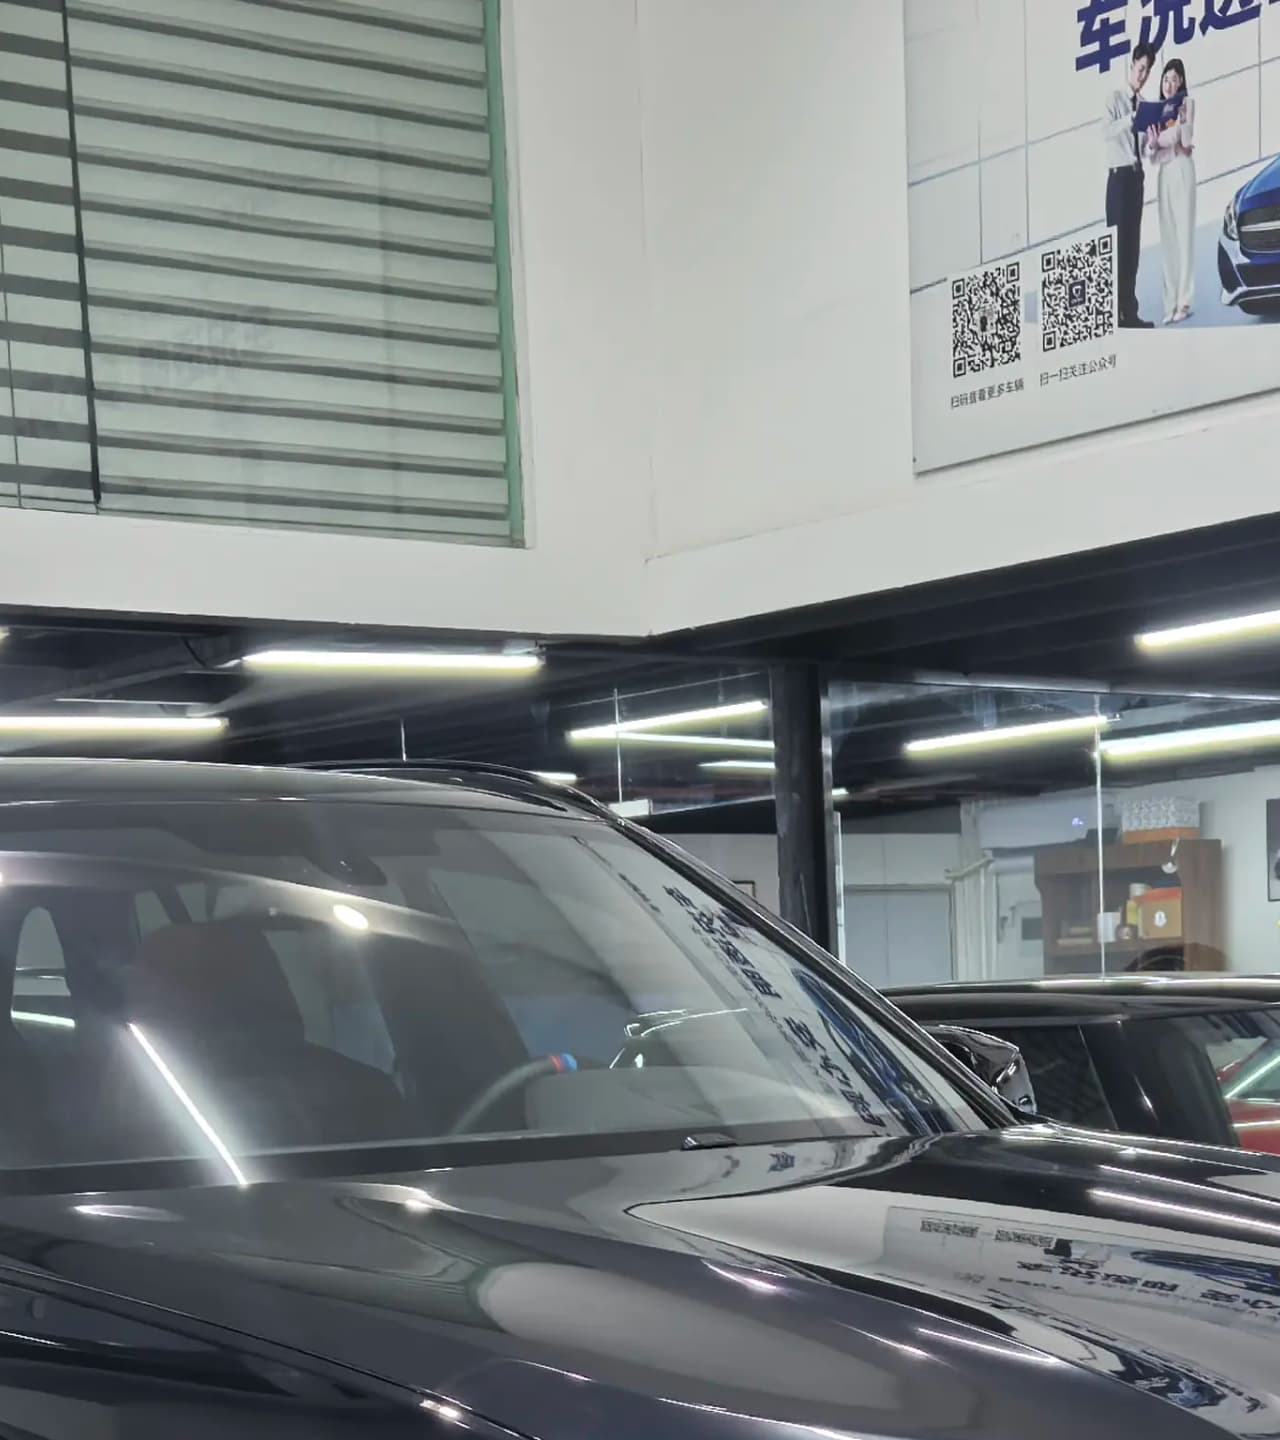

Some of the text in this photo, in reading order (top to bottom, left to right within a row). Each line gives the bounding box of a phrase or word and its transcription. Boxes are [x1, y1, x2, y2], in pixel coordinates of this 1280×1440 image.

[1040, 354, 1117, 387] 扫一扫关注公众号
[950, 378, 1024, 409] 扫码查看更多车辆
